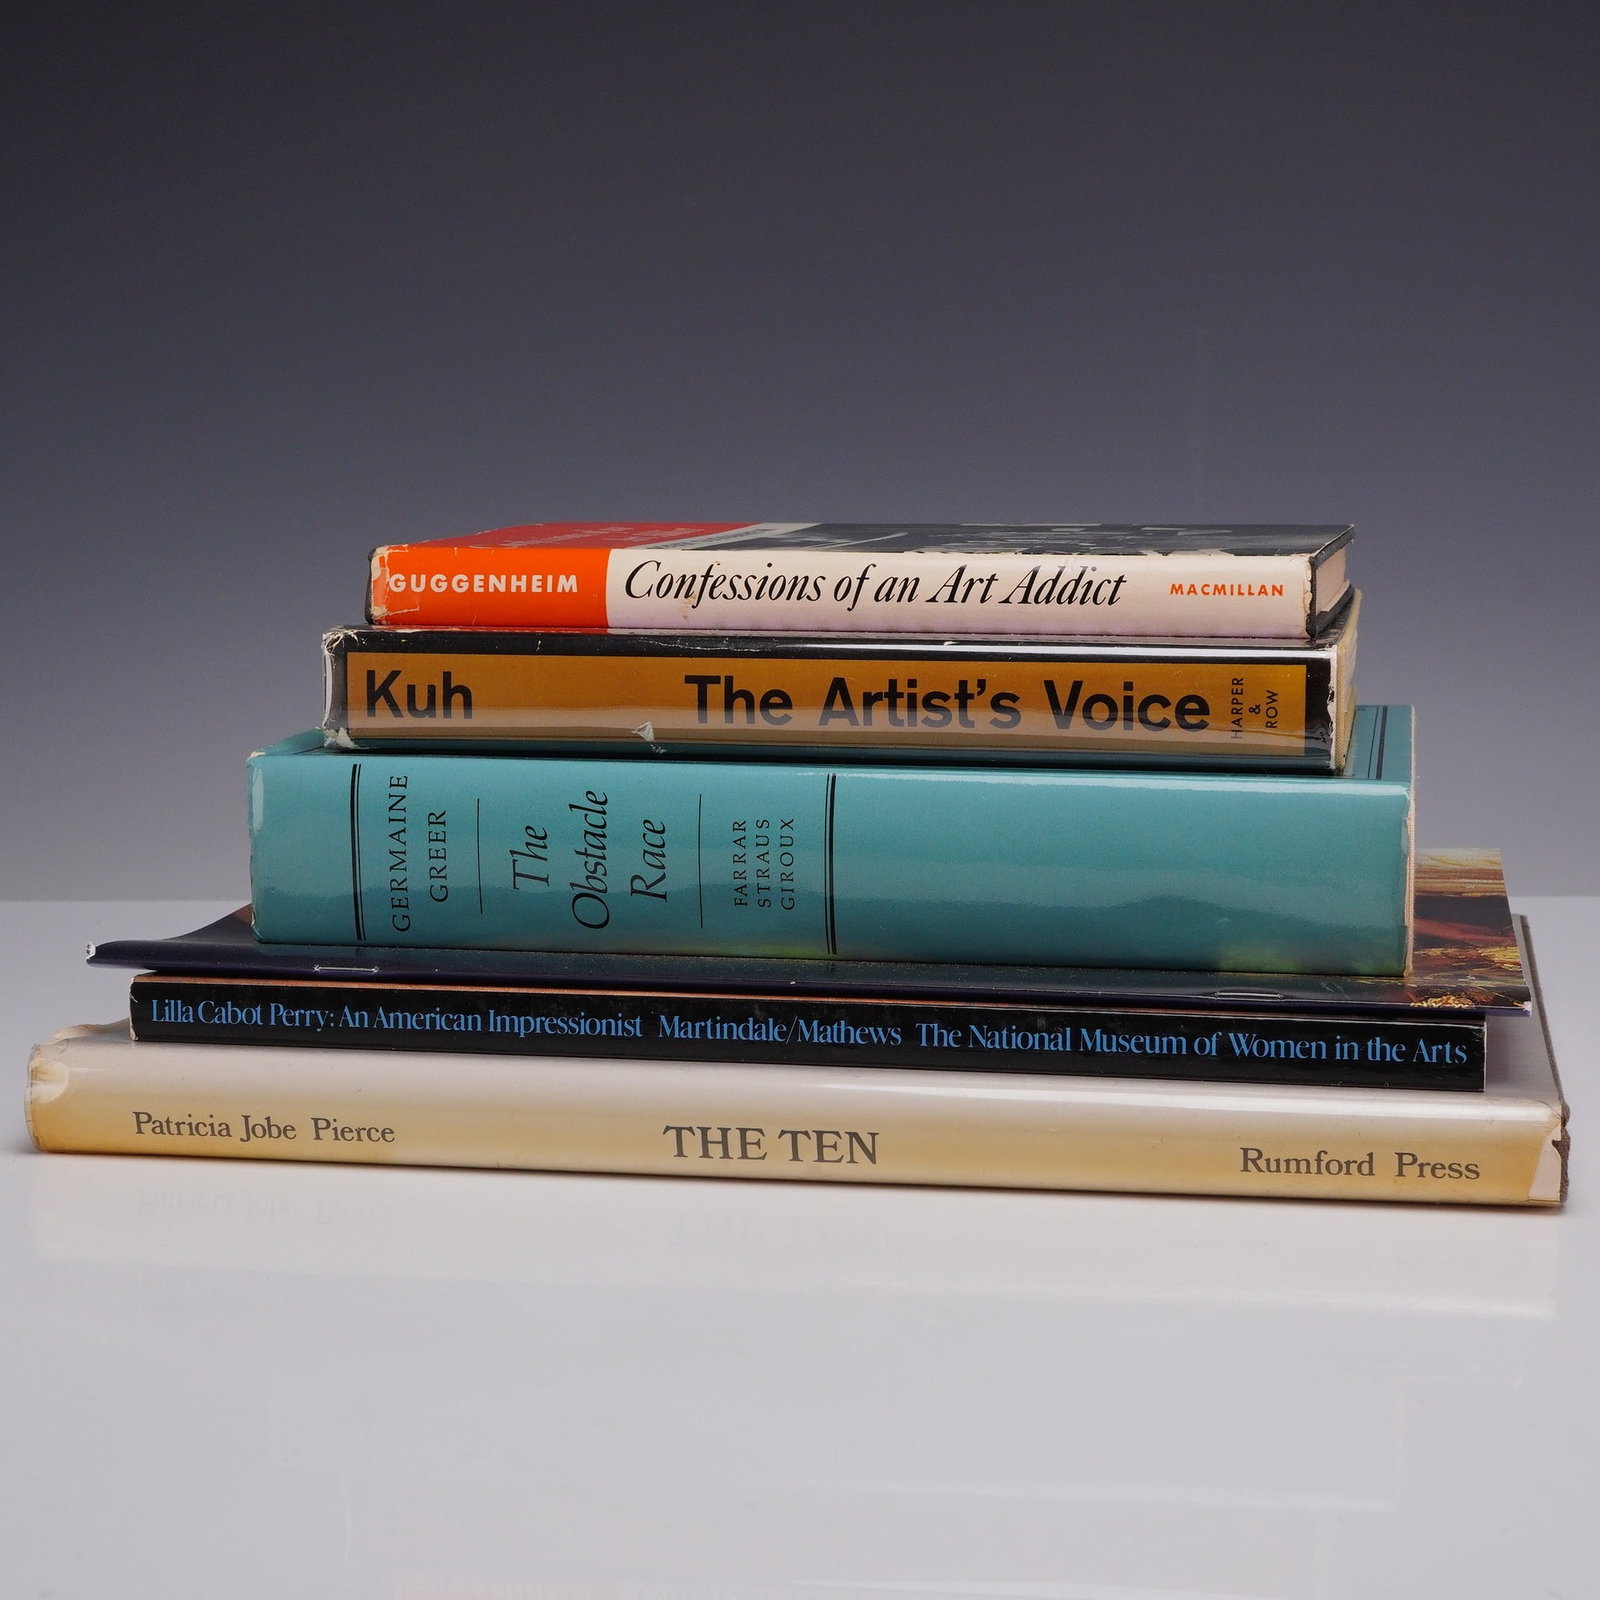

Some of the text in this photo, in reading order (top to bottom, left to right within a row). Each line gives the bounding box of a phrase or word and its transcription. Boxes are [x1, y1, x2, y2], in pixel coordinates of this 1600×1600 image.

[389, 573, 578, 594] GUGGENHEIM
[625, 560, 1128, 611] Confessions of an Art Addict
[1169, 582, 1285, 597] MACMILLAN
[365, 669, 474, 719] Kuh
[684, 674, 1211, 732] The Artist's Voice
[1230, 676, 1245, 740] HARPER
[1249, 704, 1262, 717] &
[1265, 689, 1278, 730] ROW
[388, 775, 412, 932] GERMAINE
[428, 809, 449, 903] GREER
[509, 824, 550, 891] The
[568, 789, 610, 930] Obstacle
[630, 818, 668, 902] Race
[733, 819, 748, 907] FARRAR
[756, 818, 771, 908] STRAUS
[780, 818, 795, 911] GIROUX
[151, 999, 643, 1039] Lilla Cabot Perry: An American Impressionist
[915, 1022, 1468, 1065] The National Museum of Women in the Arts
[133, 1111, 396, 1144] Patricia Jobe Pierce
[662, 1124, 880, 1165] THE TEN
[1239, 1146, 1480, 1180] Rumford Press
